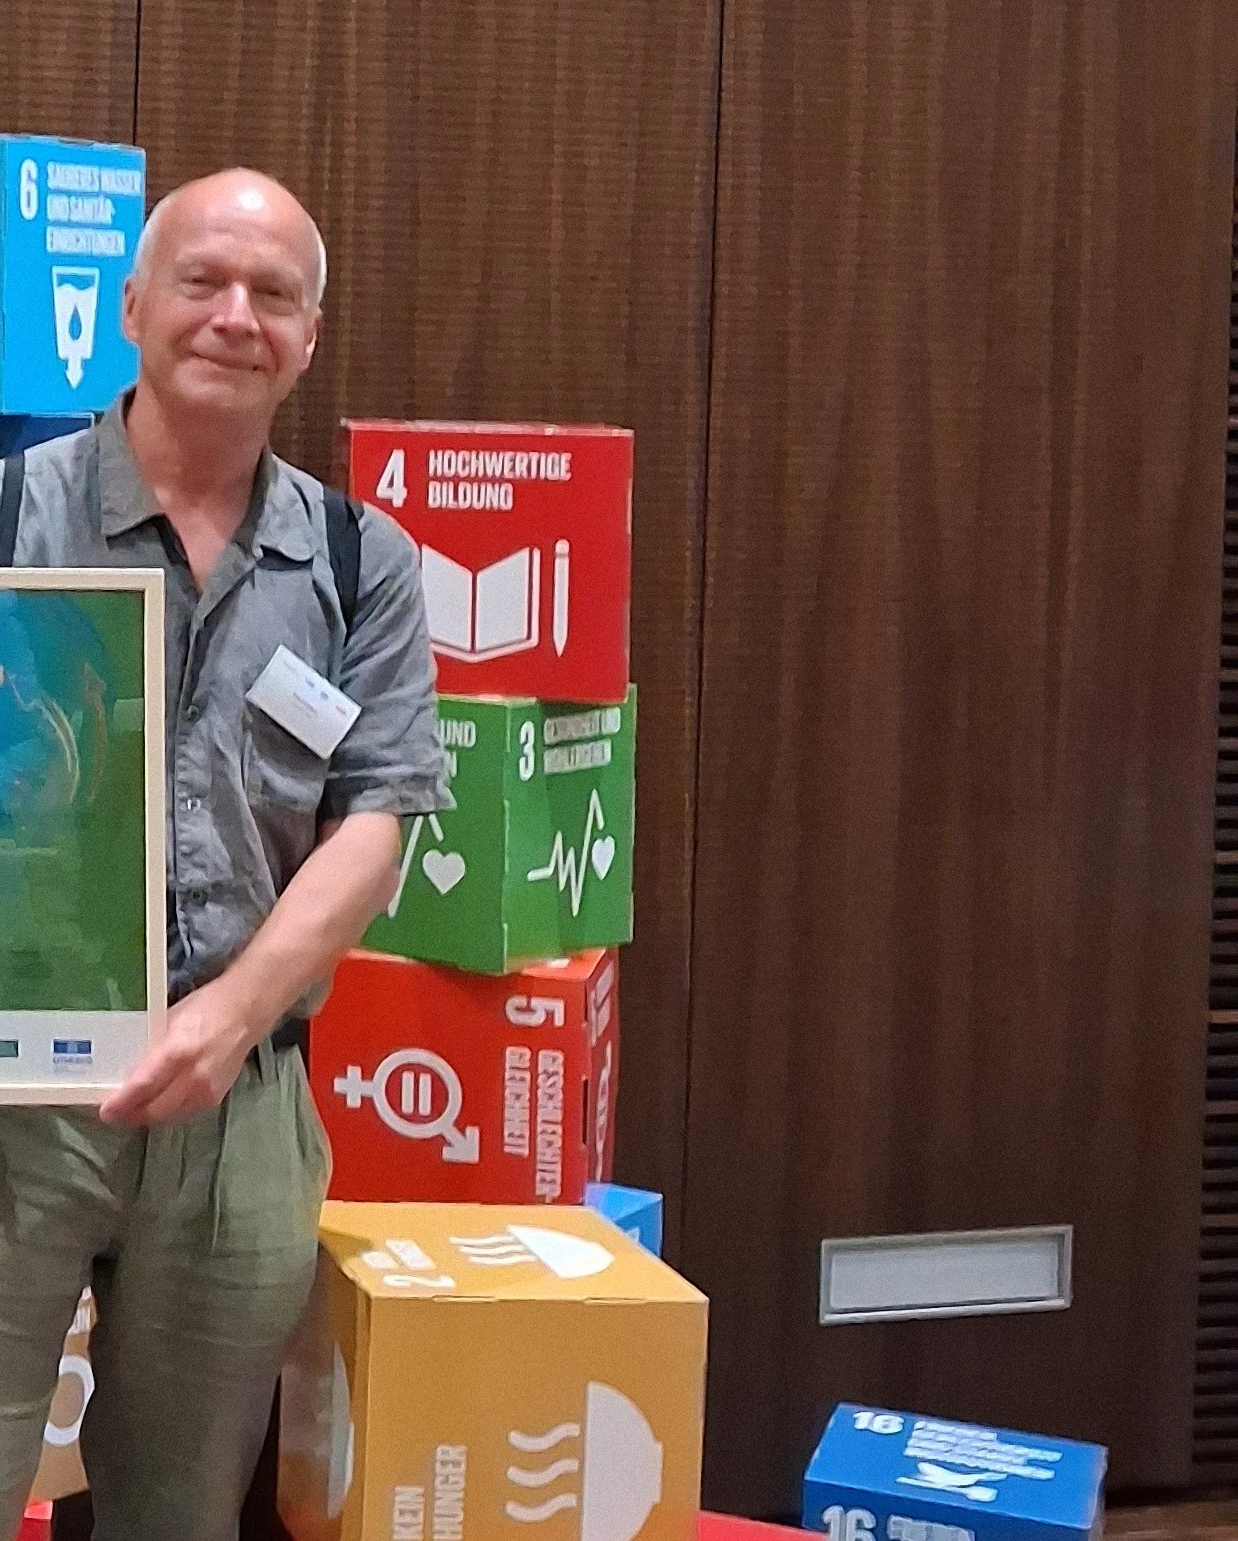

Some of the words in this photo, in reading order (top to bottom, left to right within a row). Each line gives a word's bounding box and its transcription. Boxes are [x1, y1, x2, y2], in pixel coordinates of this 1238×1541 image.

[20, 159, 38, 220] 6
[376, 449, 408, 508] 4
[428, 450, 573, 481] HOCHWERTIGE
[428, 481, 514, 511] BILDUNG
[519, 720, 535, 781] 3
[505, 996, 565, 1027] 5
[852, 1411, 905, 1434] 16
[393, 1485, 425, 1540] KEIN
[433, 1444, 468, 1540] HUNGER
